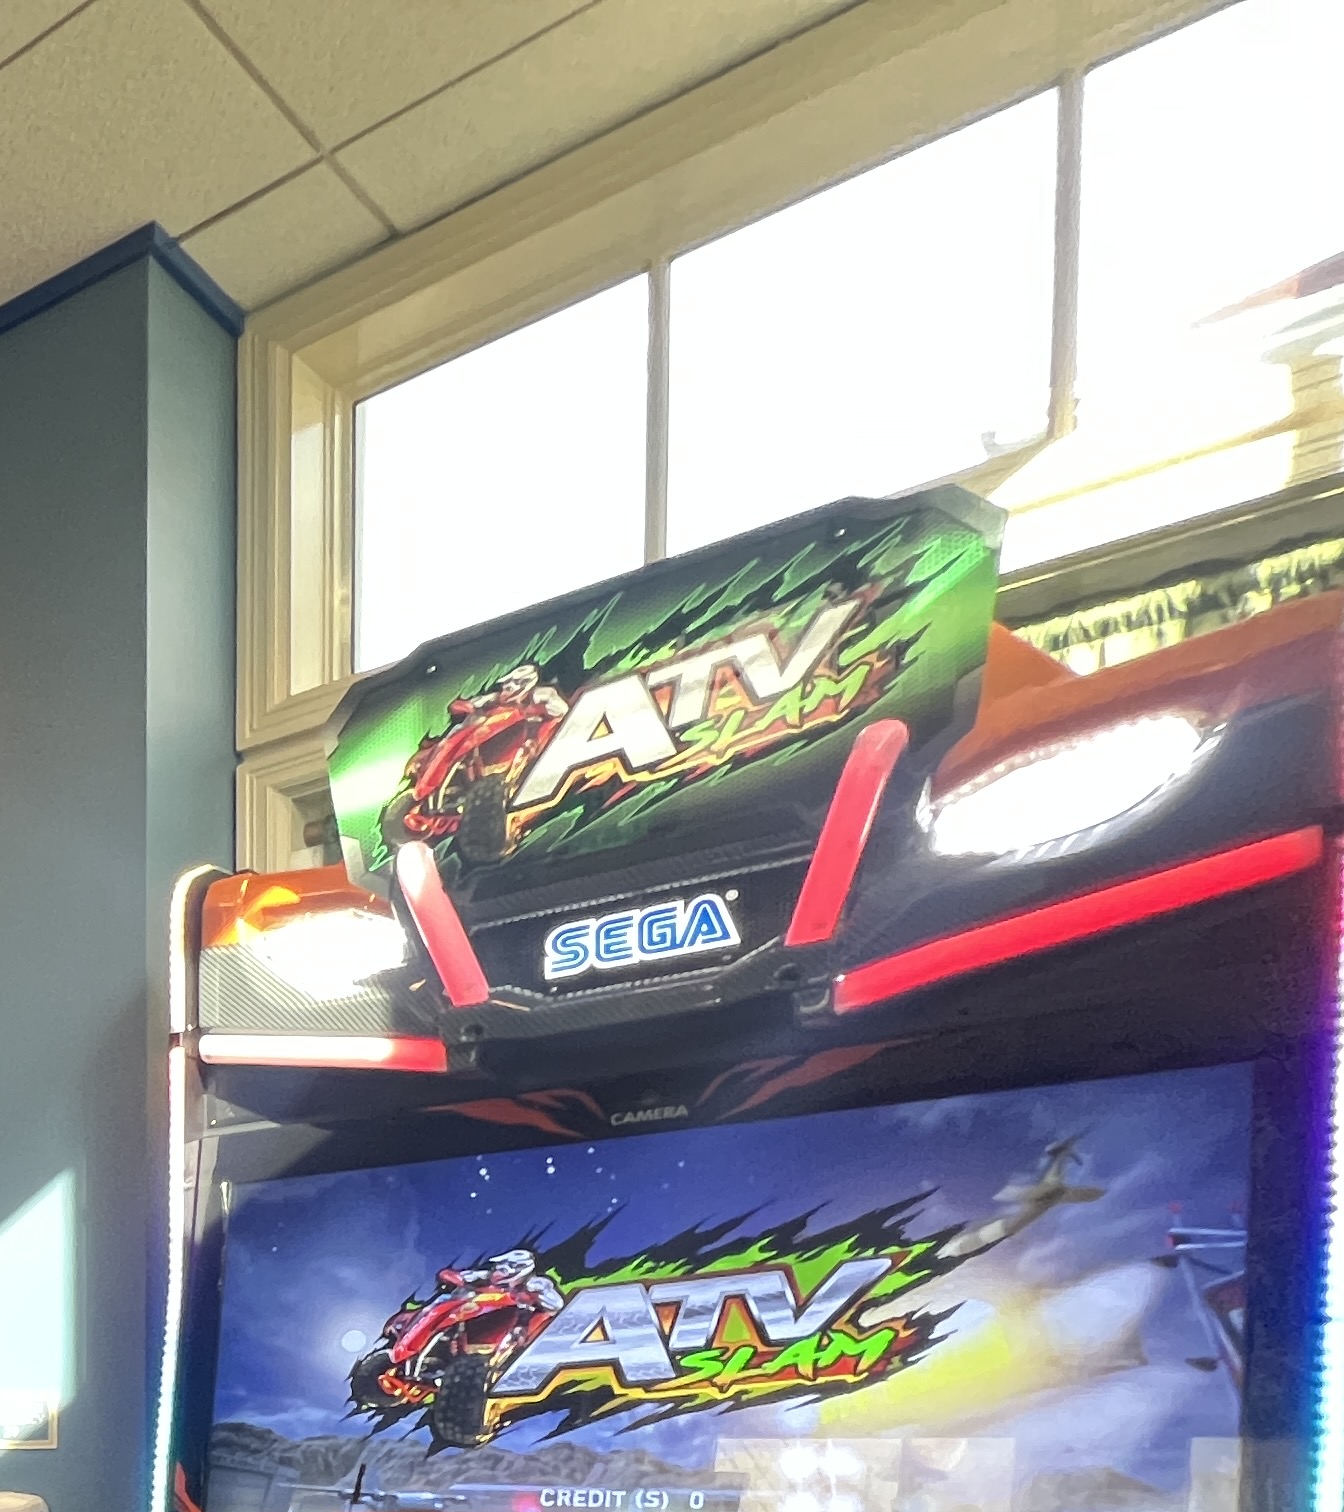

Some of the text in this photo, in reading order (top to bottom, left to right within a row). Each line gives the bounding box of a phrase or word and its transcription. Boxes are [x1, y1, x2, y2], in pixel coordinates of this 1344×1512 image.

[512, 600, 861, 808] ATV
[680, 665, 872, 747] SLAM
[547, 896, 739, 977] SEGA
[610, 1104, 689, 1126] CAMERA
[492, 1257, 893, 1393] ATV
[679, 1328, 896, 1381] SLAM
[540, 1488, 626, 1508] CREDIT
[634, 1489, 670, 1510] (S)
